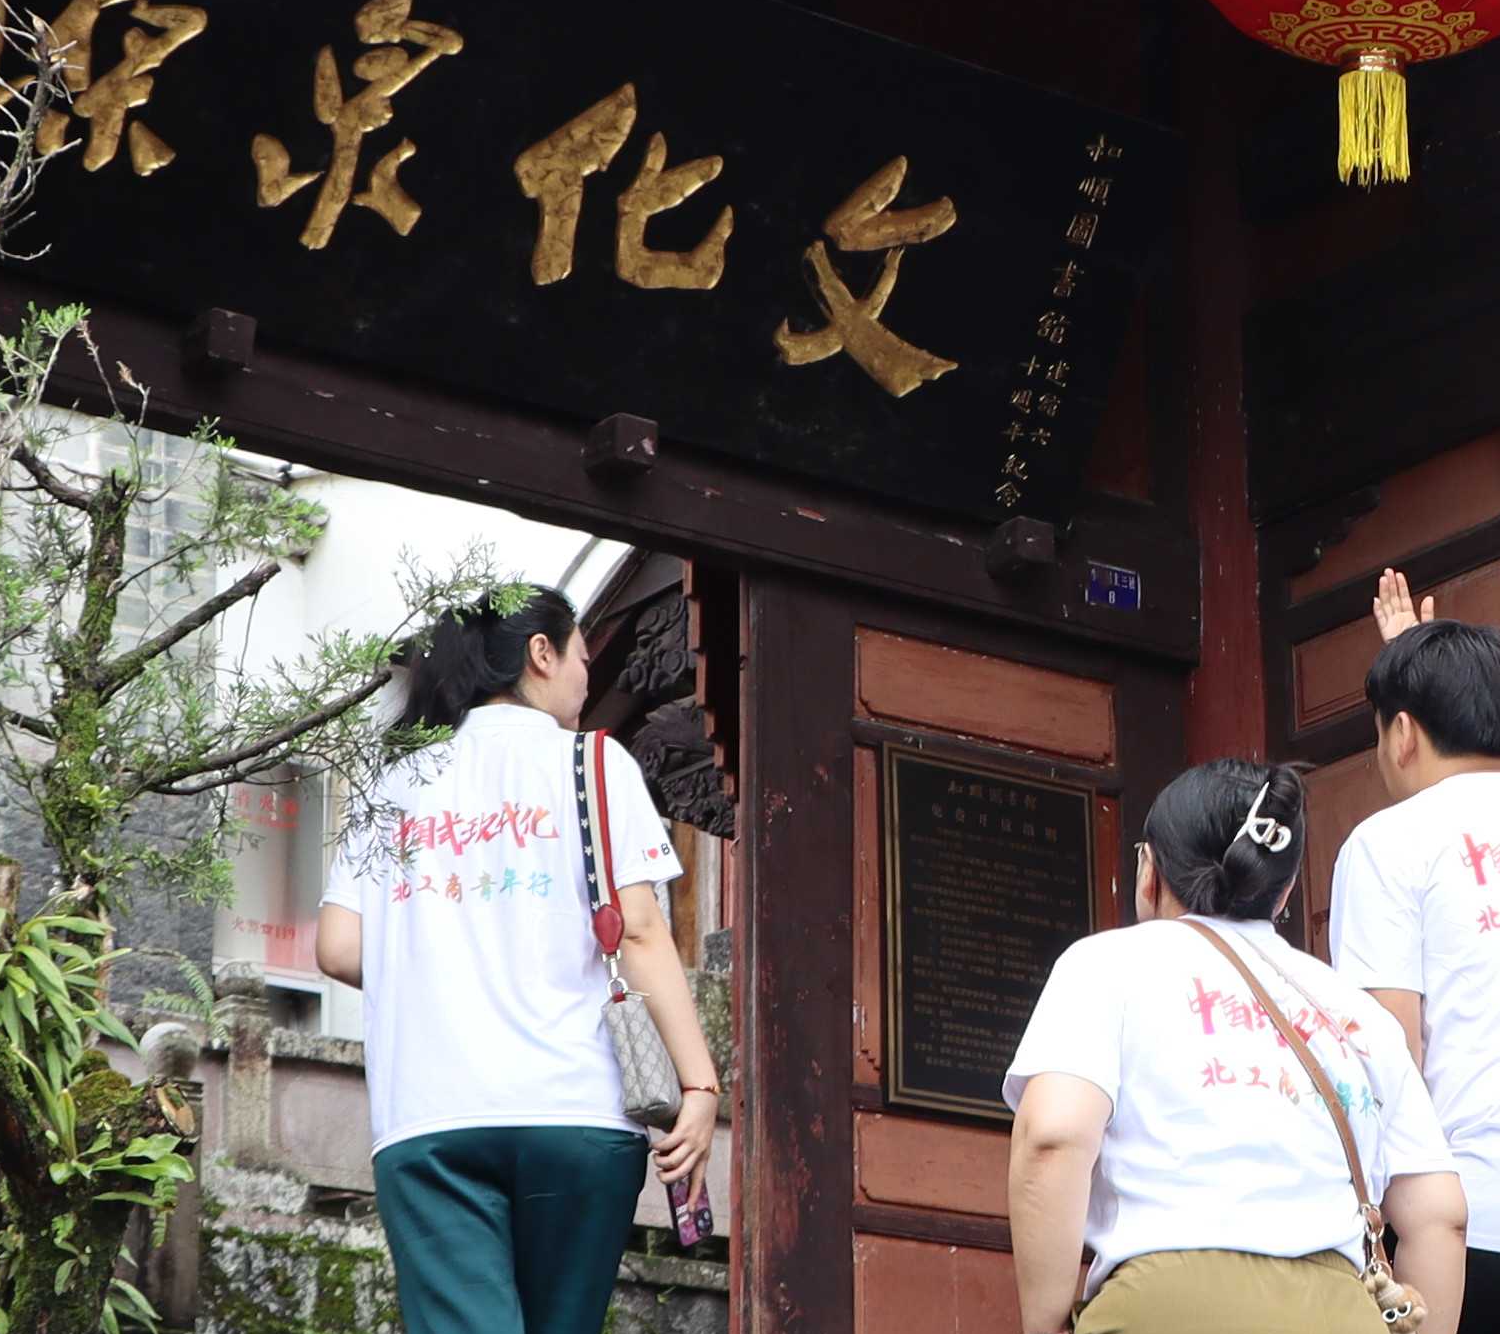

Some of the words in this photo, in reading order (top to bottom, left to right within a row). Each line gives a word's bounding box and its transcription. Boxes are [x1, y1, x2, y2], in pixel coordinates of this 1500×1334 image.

[391, 867, 553, 904] 北工商青年行
